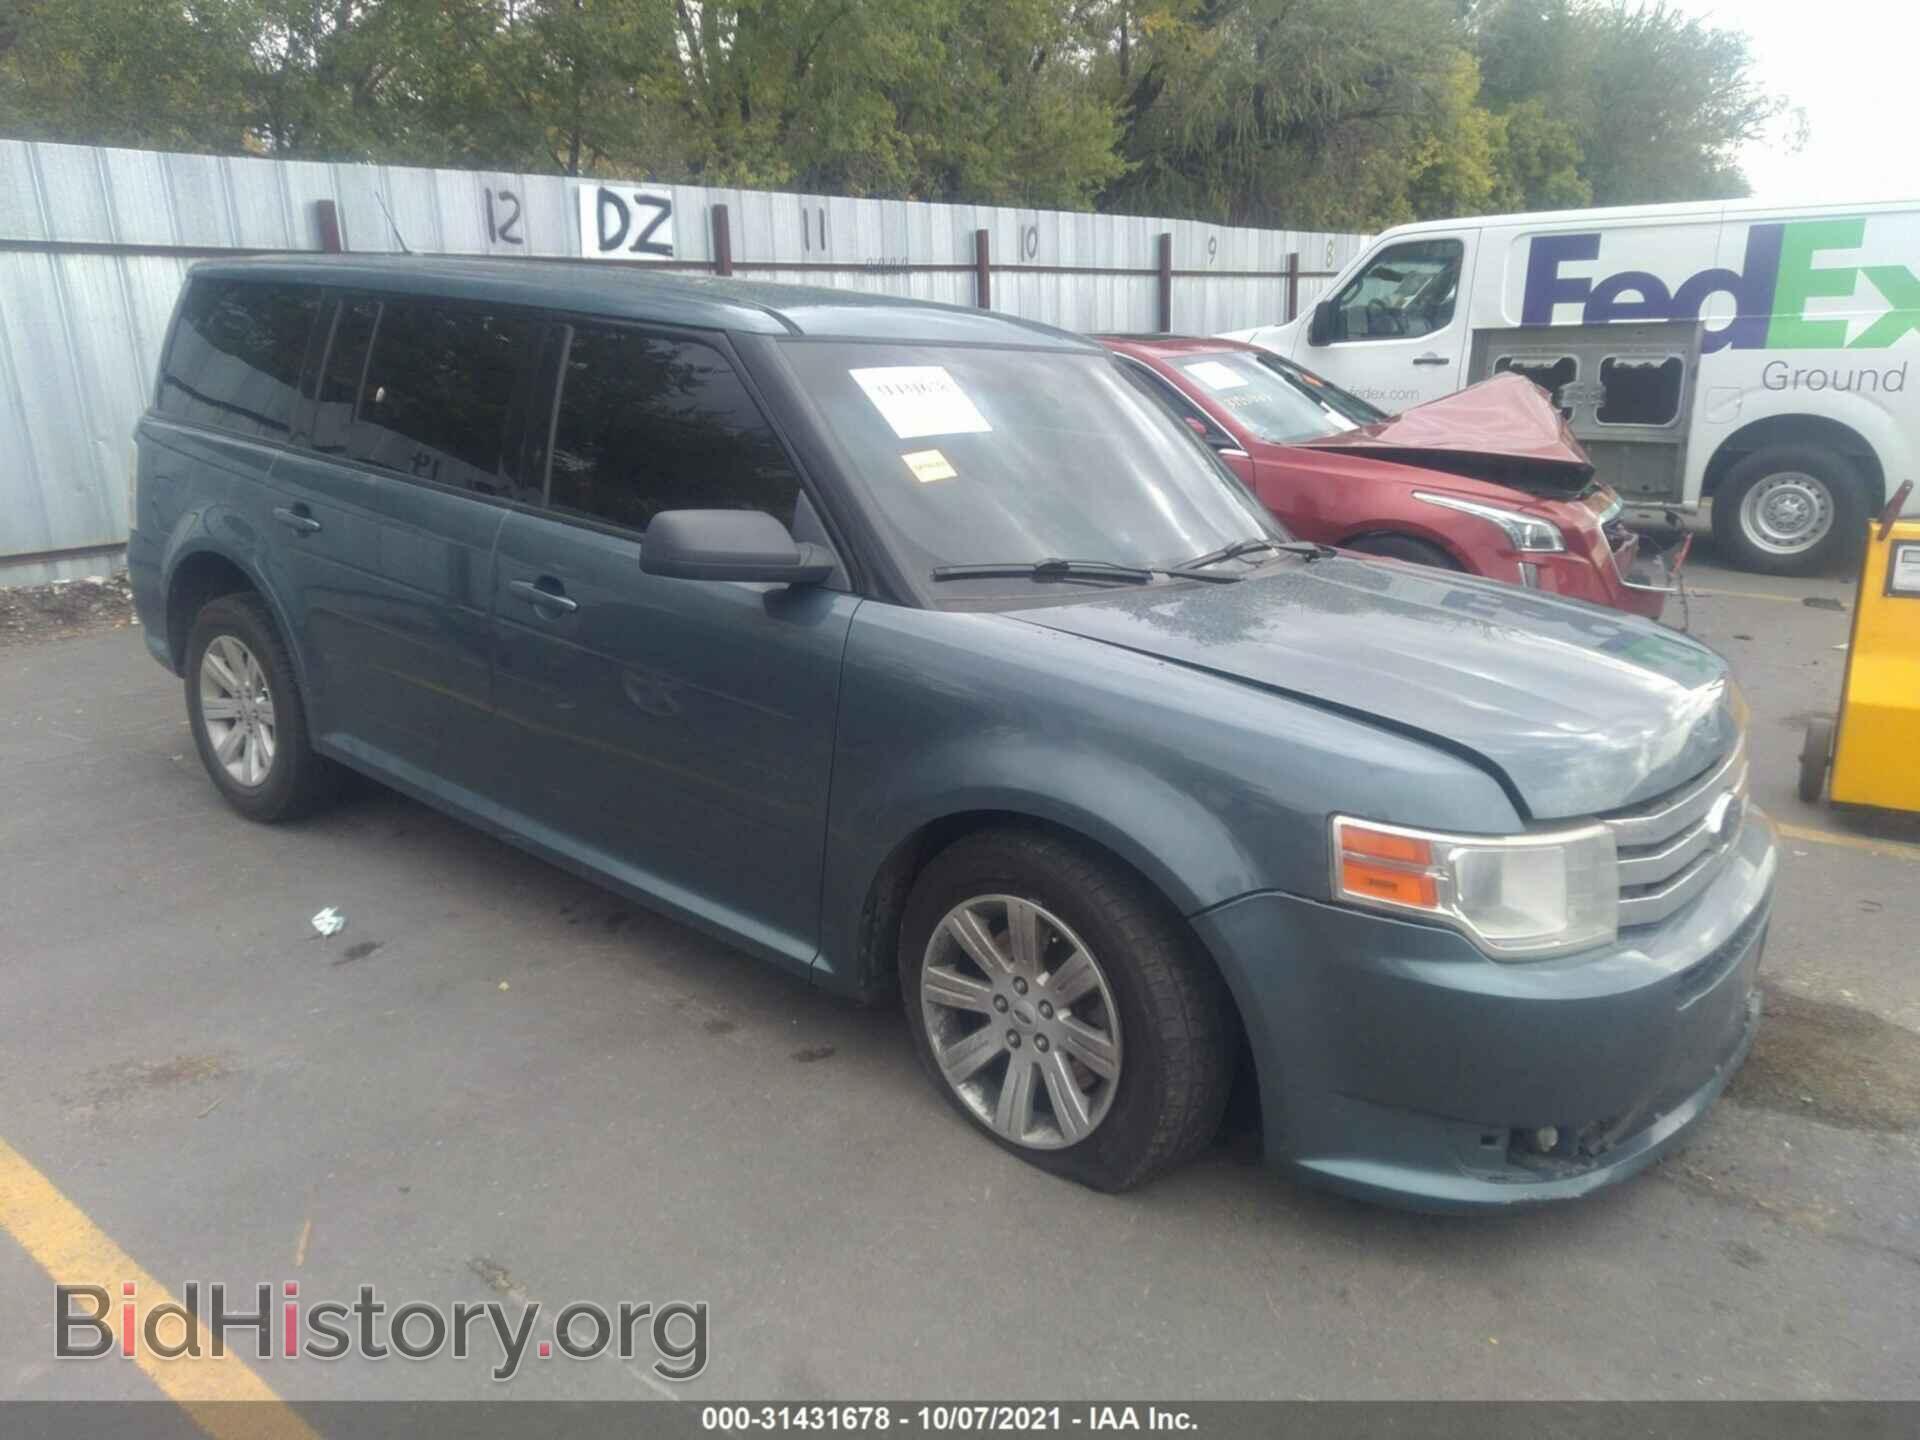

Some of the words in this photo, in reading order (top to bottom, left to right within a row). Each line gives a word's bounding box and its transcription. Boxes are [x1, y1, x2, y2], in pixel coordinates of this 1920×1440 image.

[485, 186, 524, 246] 12
[597, 186, 674, 257] DZ
[803, 206, 826, 252] 11
[1019, 223, 1038, 262] 10
[1207, 236, 1217, 265] 9
[1761, 359, 1909, 393] Ground
